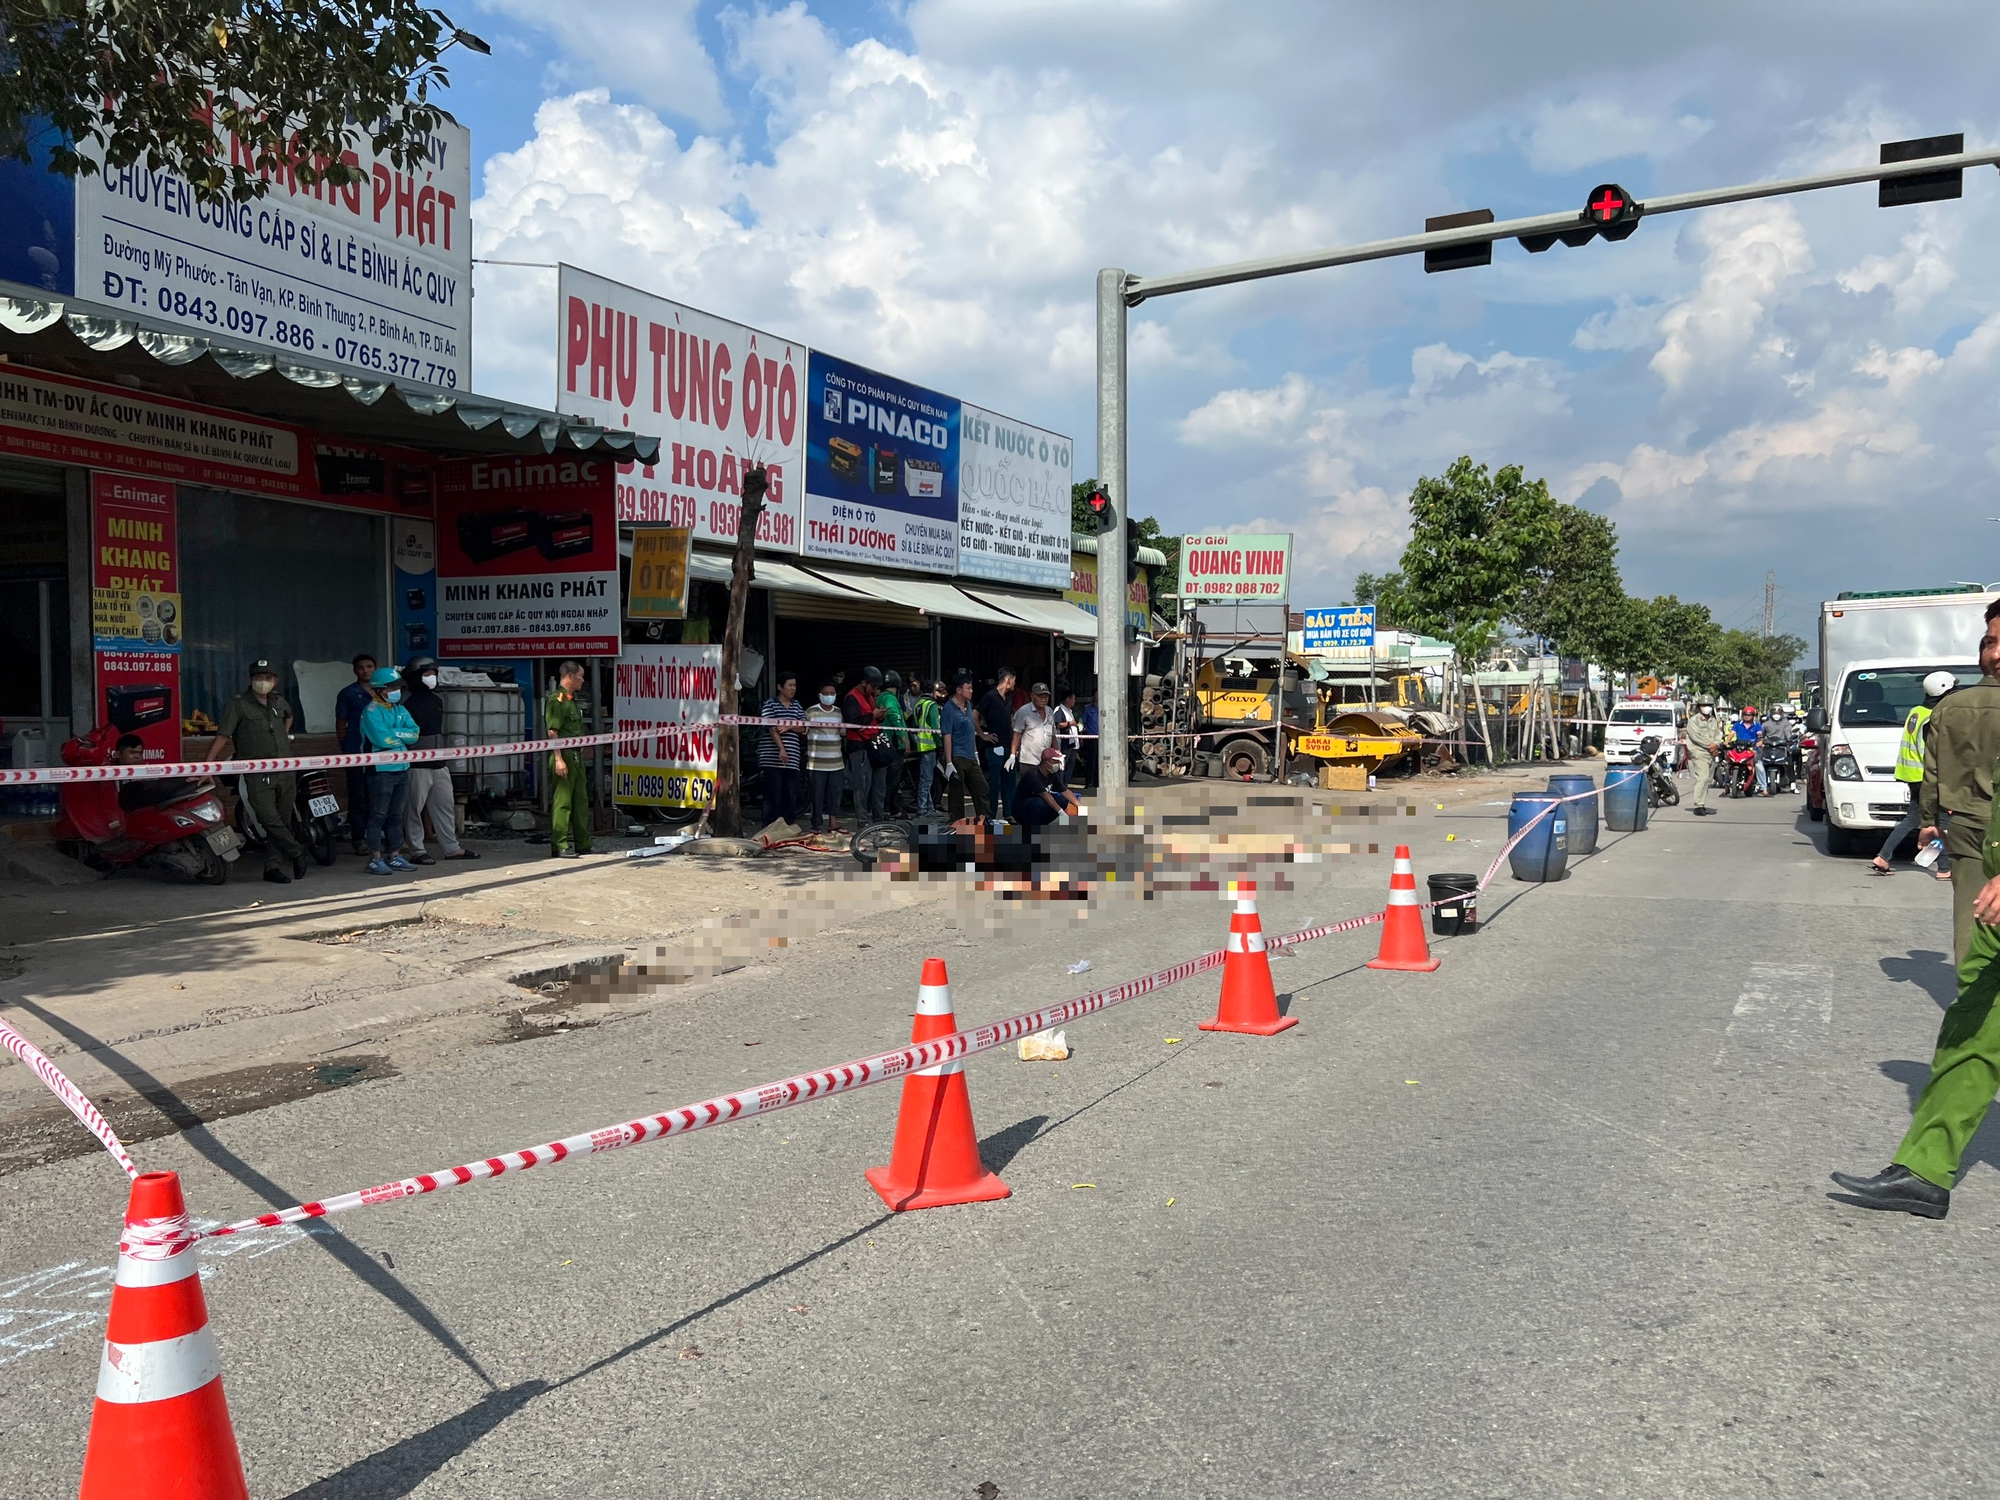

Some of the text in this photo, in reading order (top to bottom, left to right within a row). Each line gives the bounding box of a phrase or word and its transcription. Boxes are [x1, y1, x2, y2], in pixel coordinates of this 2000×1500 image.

[373, 162, 456, 250] PHÁT
[104, 161, 190, 217] CHUYÊN
[259, 209, 295, 250] CẤP
[301, 221, 316, 260] SỈ
[322, 234, 333, 266] &
[338, 235, 356, 274] LẺ
[362, 243, 398, 288] BÌNH
[402, 257, 422, 296] ẮC
[427, 272, 456, 306] QUY
[104, 234, 456, 357] Đường Mỹ Phước Tân Vạn, KP. Bình Thung 2, P. Bình An, TP. Dĩ An
[103, 271, 147, 306] ĐT:
[158, 287, 315, 351] 0843.097.886
[336, 337, 457, 389] 0765.377.779
[566, 295, 797, 446] PHỤ TÙNG ÔTÔ
[826, 372, 846, 388] CÔNG
[847, 380, 856, 390] TY
[857, 383, 867, 395] CỔ
[868, 386, 885, 401] PHẦN
[886, 392, 897, 403] PIN
[907, 399, 920, 412] QUY
[920, 403, 934, 416] MIỀN
[935, 408, 948, 420] NAM
[0, 381, 28, 403] HH
[90, 394, 109, 418] ẮC
[113, 404, 142, 424] QUY
[147, 411, 185, 433] MINH
[190, 419, 236, 443] KHANG
[240, 430, 273, 449] PHÁT
[847, 397, 948, 450] PINACO
[963, 412, 1069, 468] KẾT NƯỚC Ô TÔ
[471, 459, 598, 490] Enimac
[962, 456, 1070, 516] QUỐC BẢO
[113, 484, 166, 505] Enimac
[832, 505, 876, 523] ĐIỆN Ô TÔ
[962, 502, 975, 514] Hàn
[995, 511, 1008, 523] thay
[1009, 514, 1020, 525] mới
[1021, 516, 1030, 527] các
[108, 517, 163, 542] MINH
[636, 532, 688, 555] PHỤ TÙNG
[809, 520, 896, 552] THÁI DƯƠNG
[905, 523, 953, 542] CHUYÊN MUA BÁN
[961, 518, 1069, 550] KẾT NƯỚC KẾT KẾT NHỚT Ô TÔ
[1186, 536, 1228, 545] Cơ Giới
[101, 546, 170, 571] KHANG
[921, 544, 934, 556] BÌNH
[943, 548, 955, 560] QUY
[961, 536, 1069, 564] CƠ GIỚI THÙNG DẦU HÀN NHÔM
[1189, 550, 1284, 577] QUANG VINH
[445, 576, 607, 601] MINH KHANG PHÁT
[640, 559, 678, 590] Ô TÔ
[1185, 583, 1280, 594] ĐT: 0982 088 702
[445, 606, 609, 621] CHUYÊN CUNG CẤP ẮC QUY NỘI NGOẠI NHẬP
[1306, 607, 1373, 628] SÁU TIẾN
[461, 623, 591, 634] 0847.097.886 0843.097.886
[1306, 627, 1372, 639] MUA BÁN VỎ XE CƠ GIỚI
[103, 661, 172, 672] 0843.097.886
[616, 663, 632, 706] PHỤ
[634, 655, 656, 699] TÙNG
[658, 656, 663, 699] Ô
[666, 656, 677, 700] TÔ
[679, 661, 692, 700] RƠ
[655, 711, 714, 763] HOÀNG
[616, 773, 712, 801] LH: 0989 987 679
